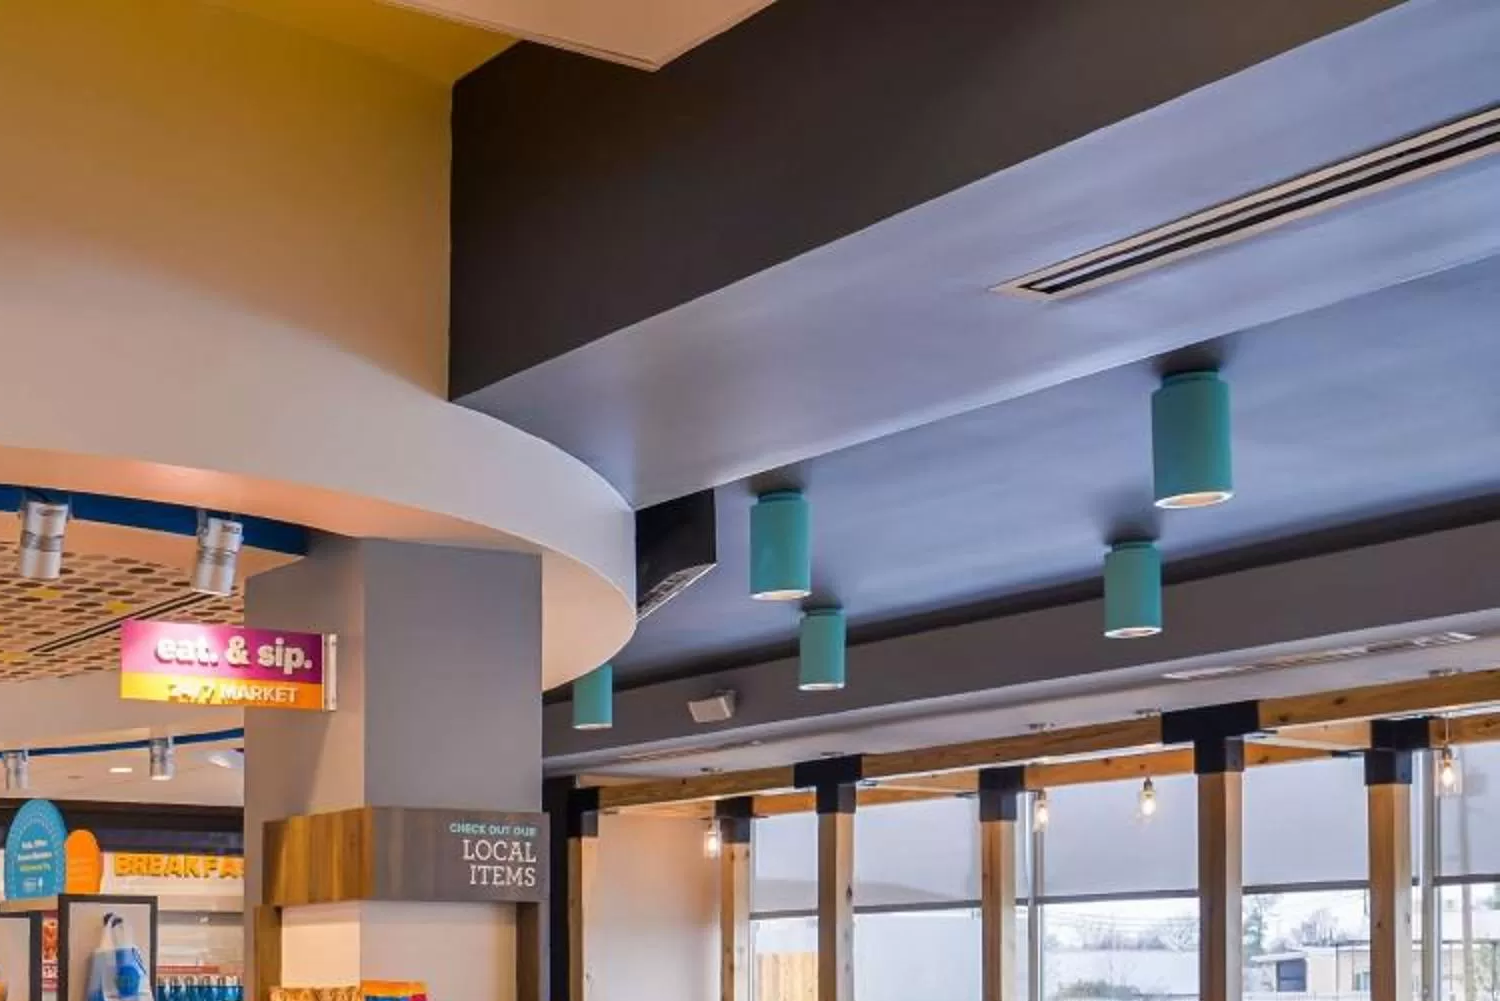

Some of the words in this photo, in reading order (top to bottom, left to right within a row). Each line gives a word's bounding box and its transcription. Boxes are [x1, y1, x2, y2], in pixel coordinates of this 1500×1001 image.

[156, 636, 219, 665] eat.
[226, 635, 251, 666] &
[257, 637, 313, 675] sip.
[220, 684, 298, 703] MARKET
[450, 822, 487, 834] CHECK
[488, 825, 511, 835] OUT
[513, 827, 537, 837] OUR
[462, 839, 537, 863] LOCAL
[115, 853, 244, 878] BREAKFA
[469, 865, 536, 887] ITEMS
